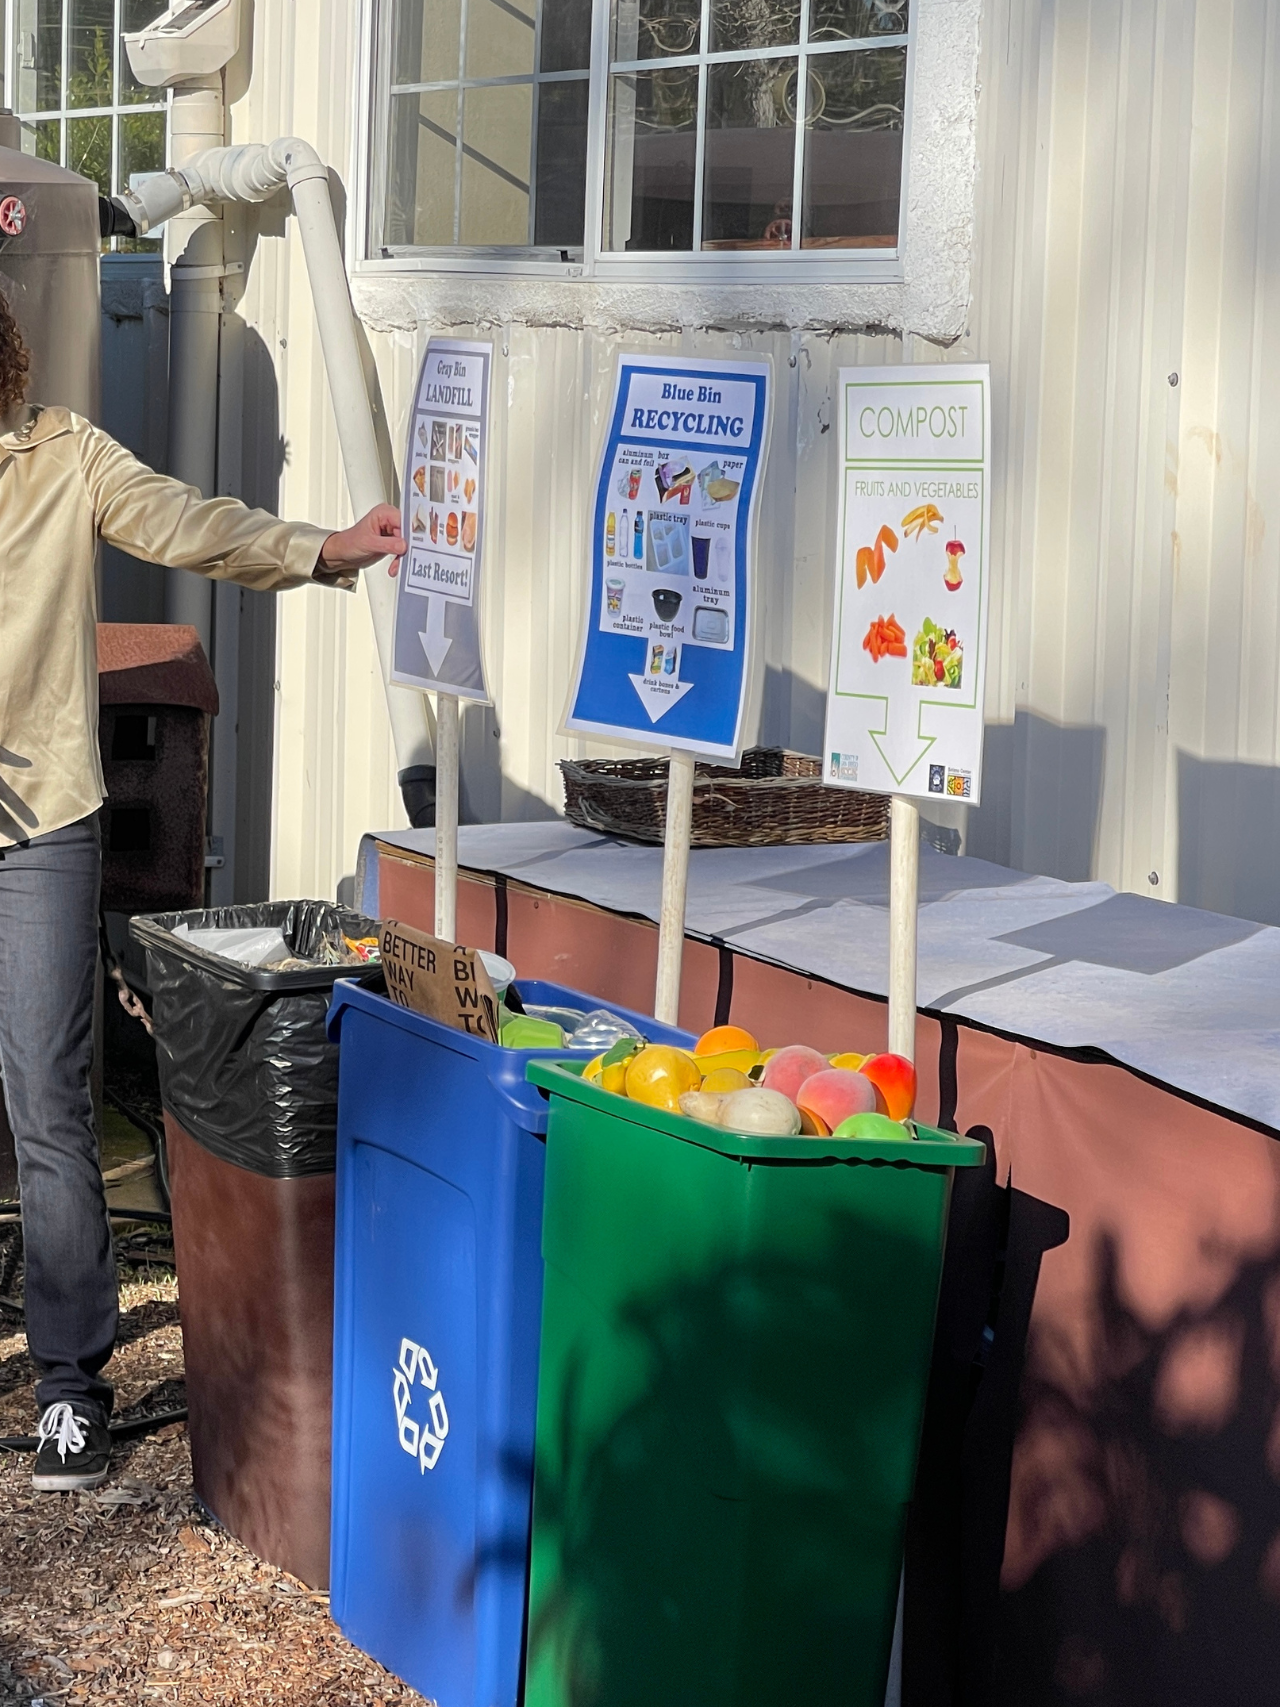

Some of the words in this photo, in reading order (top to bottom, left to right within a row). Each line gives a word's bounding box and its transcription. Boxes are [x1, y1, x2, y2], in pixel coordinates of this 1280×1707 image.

[437, 359, 453, 379] Gray
[453, 361, 467, 377] Bin
[425, 383, 474, 407] LANDFILL
[661, 383, 694, 401] Blue
[696, 386, 722, 404] Bin
[630, 408, 744, 438] RECYCLING
[859, 405, 968, 438] COMPOST
[622, 448, 654, 459] aluminum
[658, 450, 670, 460] box
[630, 458, 642, 466] and
[643, 459, 655, 467] foil
[722, 460, 743, 469] paper
[855, 480, 885, 497] FRUITS
[887, 481, 911, 497] AND
[914, 482, 979, 499] VEGETABLES
[648, 511, 672, 523] plastic
[673, 516, 688, 526] tray
[695, 519, 715, 529] plastic
[716, 522, 731, 530] cups
[606, 559, 624, 569] plastic
[625, 561, 643, 570] bottles
[411, 557, 432, 580] Last
[433, 562, 469, 587] Resort!
[692, 585, 730, 597] aluminum
[703, 595, 719, 605] tray
[622, 614, 644, 624] plastic
[612, 622, 644, 632] container
[649, 621, 670, 632] plastic
[670, 624, 685, 633] food
[659, 630, 674, 638] bowl
[643, 678, 658, 687] drink
[650, 686, 671, 695] cartons
[383, 930, 437, 974] BETTER
[383, 957, 415, 992] WAY
